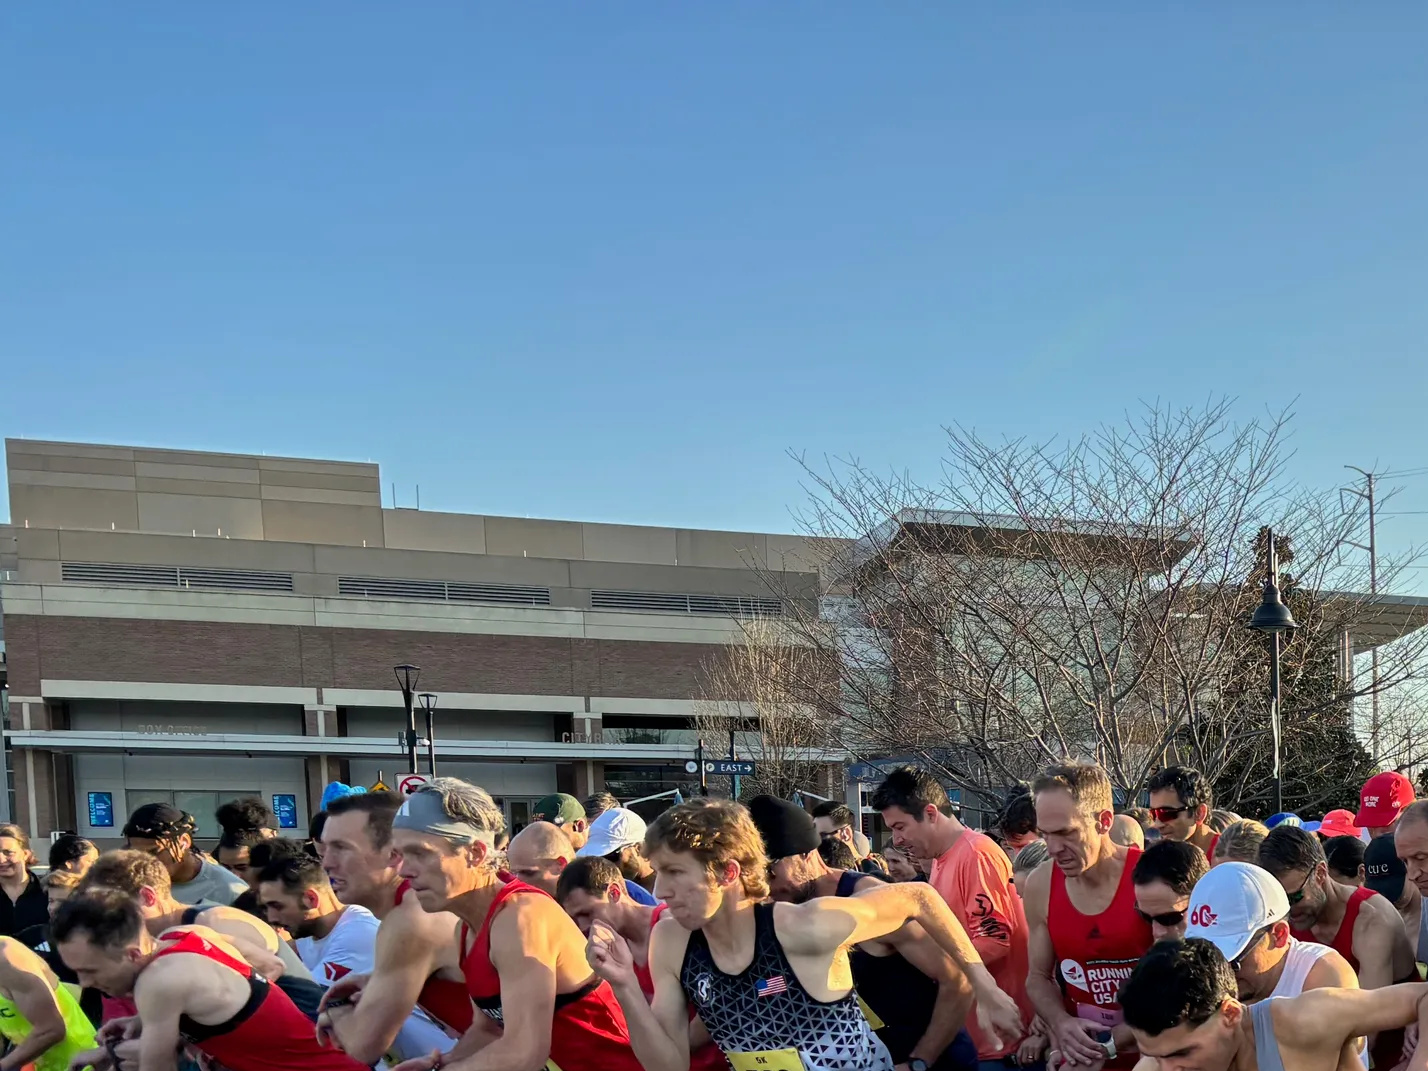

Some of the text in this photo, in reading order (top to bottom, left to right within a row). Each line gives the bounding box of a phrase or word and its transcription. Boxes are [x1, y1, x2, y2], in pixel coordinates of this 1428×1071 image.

[720, 763, 742, 772] EAST
[88, 793, 97, 825] WELCOME
[1091, 979, 1120, 994] CITY
[755, 1056, 768, 1064] 5K
